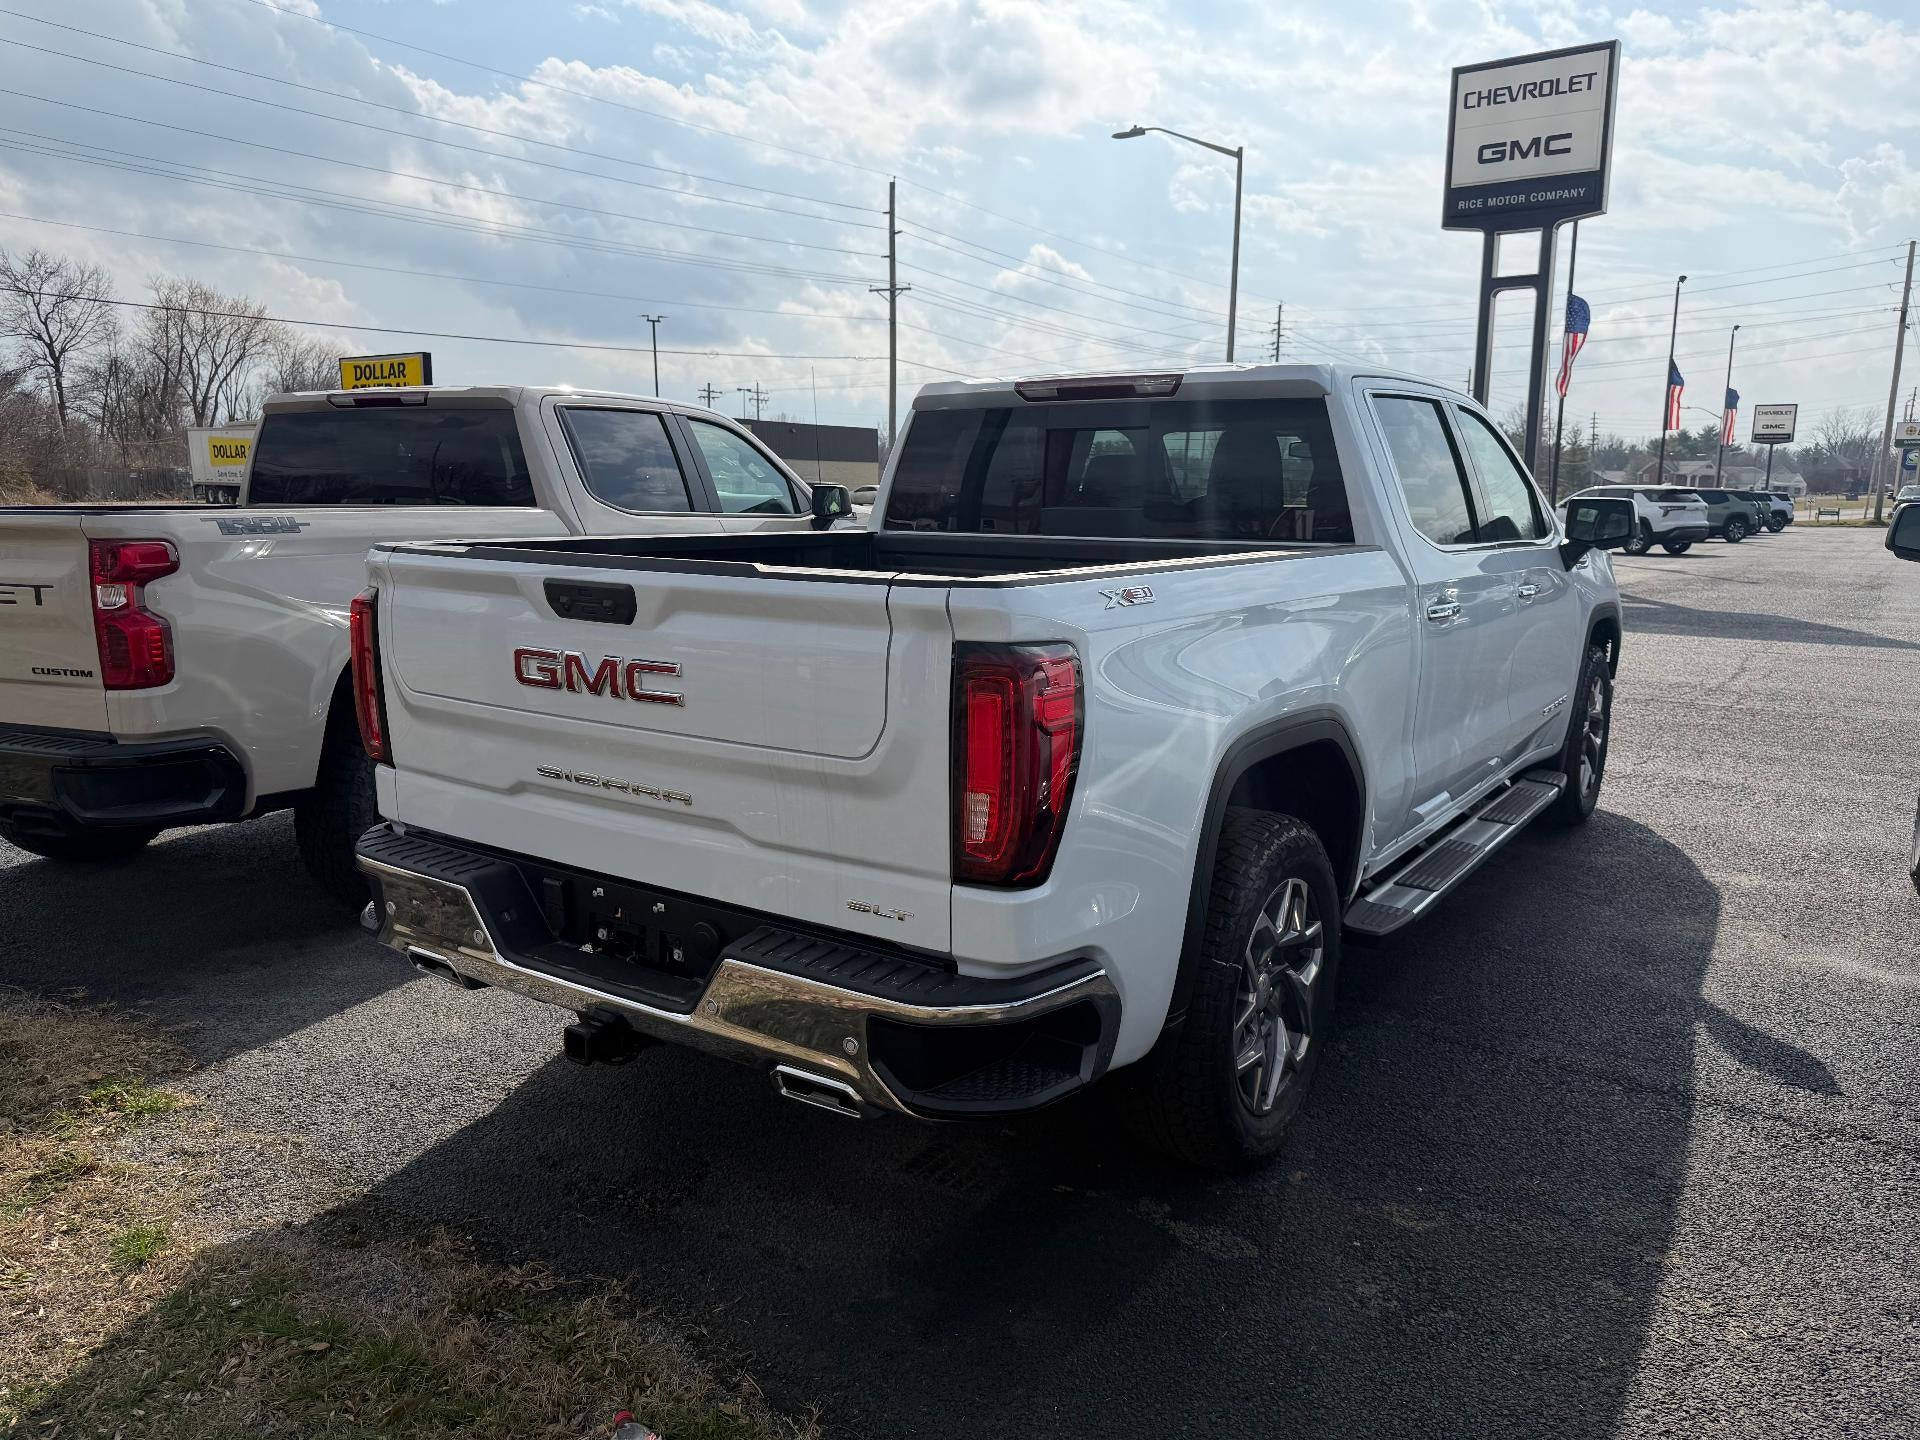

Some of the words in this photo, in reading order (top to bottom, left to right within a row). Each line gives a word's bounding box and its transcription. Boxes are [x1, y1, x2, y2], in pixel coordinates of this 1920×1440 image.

[1463, 72, 1597, 109] CHEVROLET
[1477, 132, 1573, 165] GMC
[1458, 199, 1483, 210] RICE
[1487, 194, 1526, 207] MOTOR
[1530, 187, 1586, 202] COMPANY
[353, 362, 407, 381] DOLLAR
[212, 444, 247, 459] DOLLAR
[31, 666, 93, 678] CUSTOM
[513, 645, 686, 708] GMC
[847, 899, 914, 921] SLT
